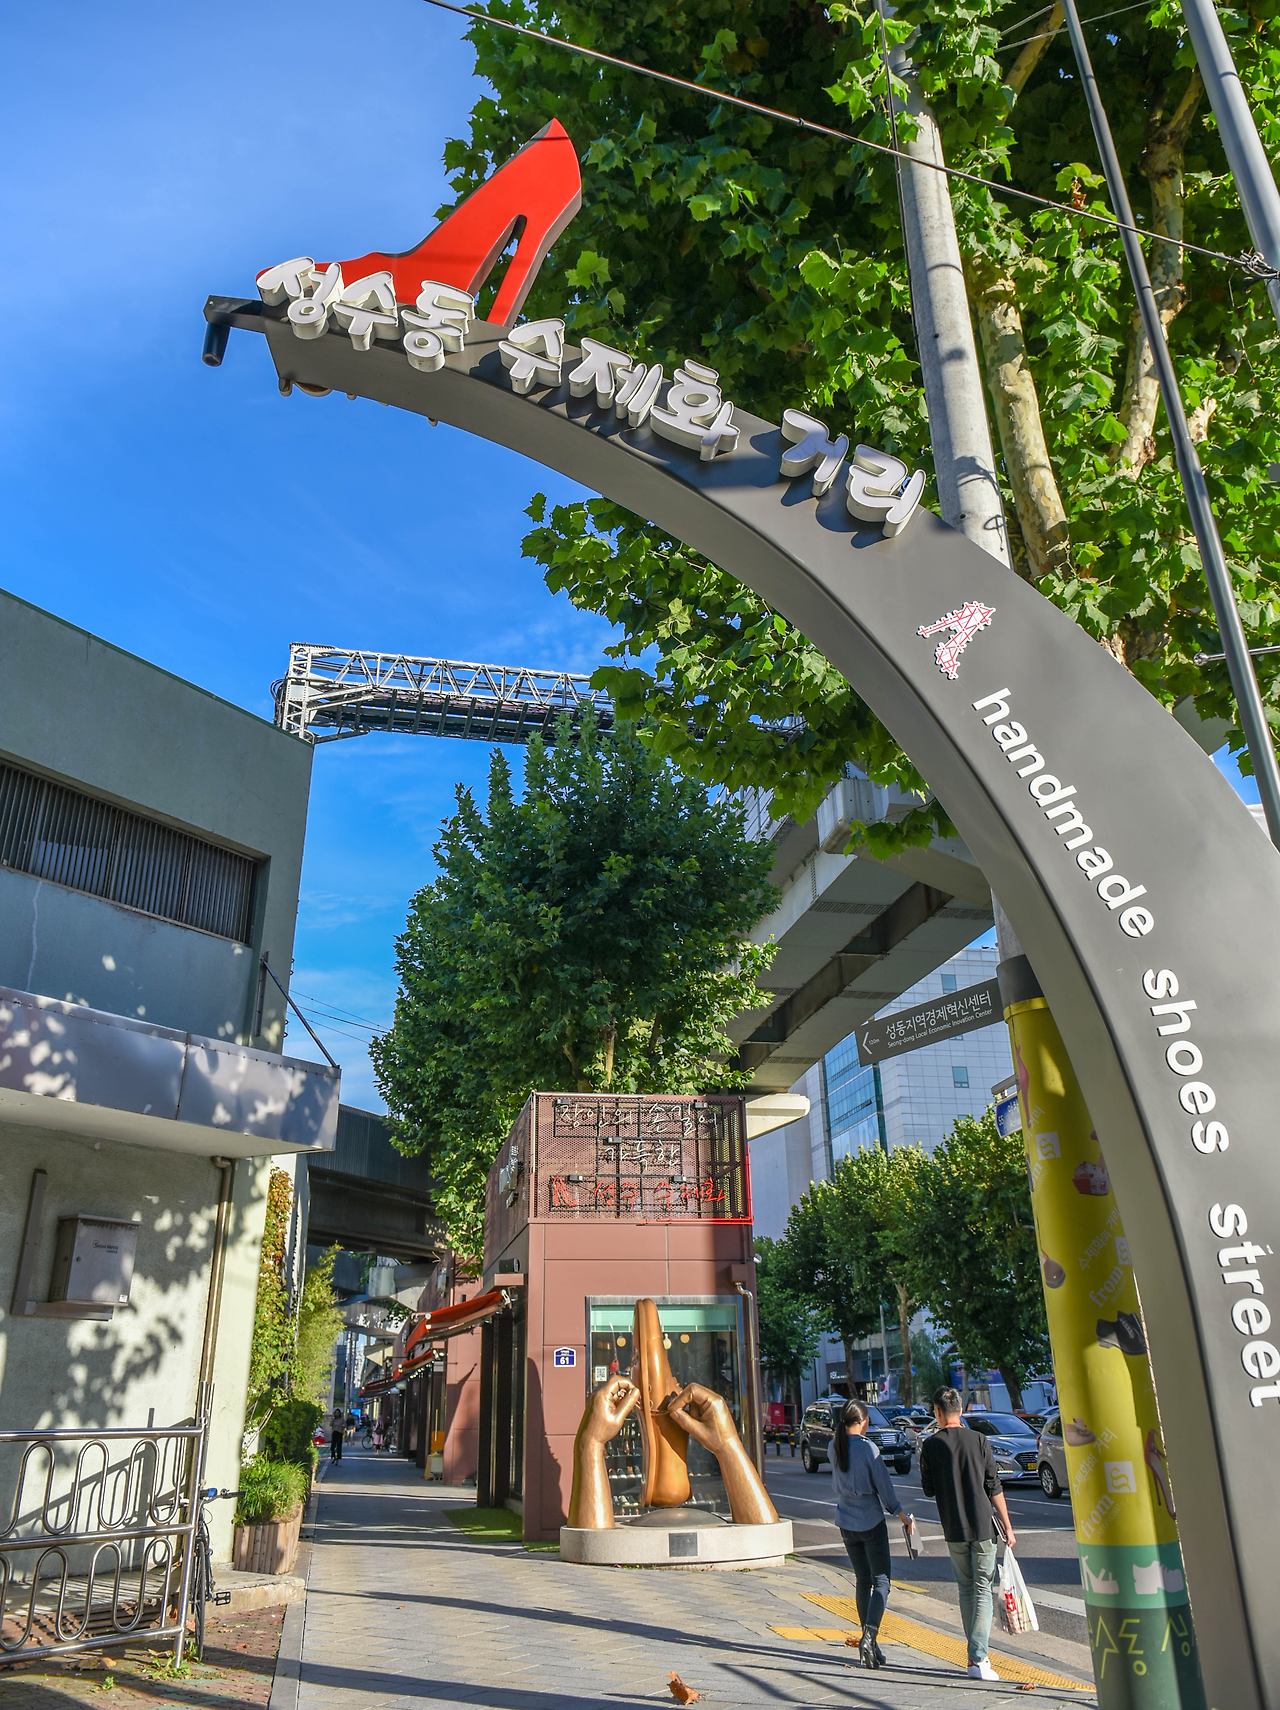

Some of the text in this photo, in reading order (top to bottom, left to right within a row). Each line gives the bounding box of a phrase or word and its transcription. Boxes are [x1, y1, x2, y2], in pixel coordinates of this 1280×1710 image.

[256, 256, 926, 537] 성수동 수제화 거리
[885, 990, 992, 1040] 성동지역경제혁신센터
[887, 1036, 915, 1049] Seong-dong
[915, 1030, 928, 1039] Local
[928, 1023, 952, 1034] Economic
[975, 1008, 993, 1019] Center
[972, 688, 1280, 1408] handmade shoes street
[560, 1104, 632, 1128] 장인의
[604, 1139, 680, 1171] 가득한
[1088, 1266, 1124, 1308] from
[560, 1356, 569, 1365] 61
[1080, 1494, 1115, 1538] from
